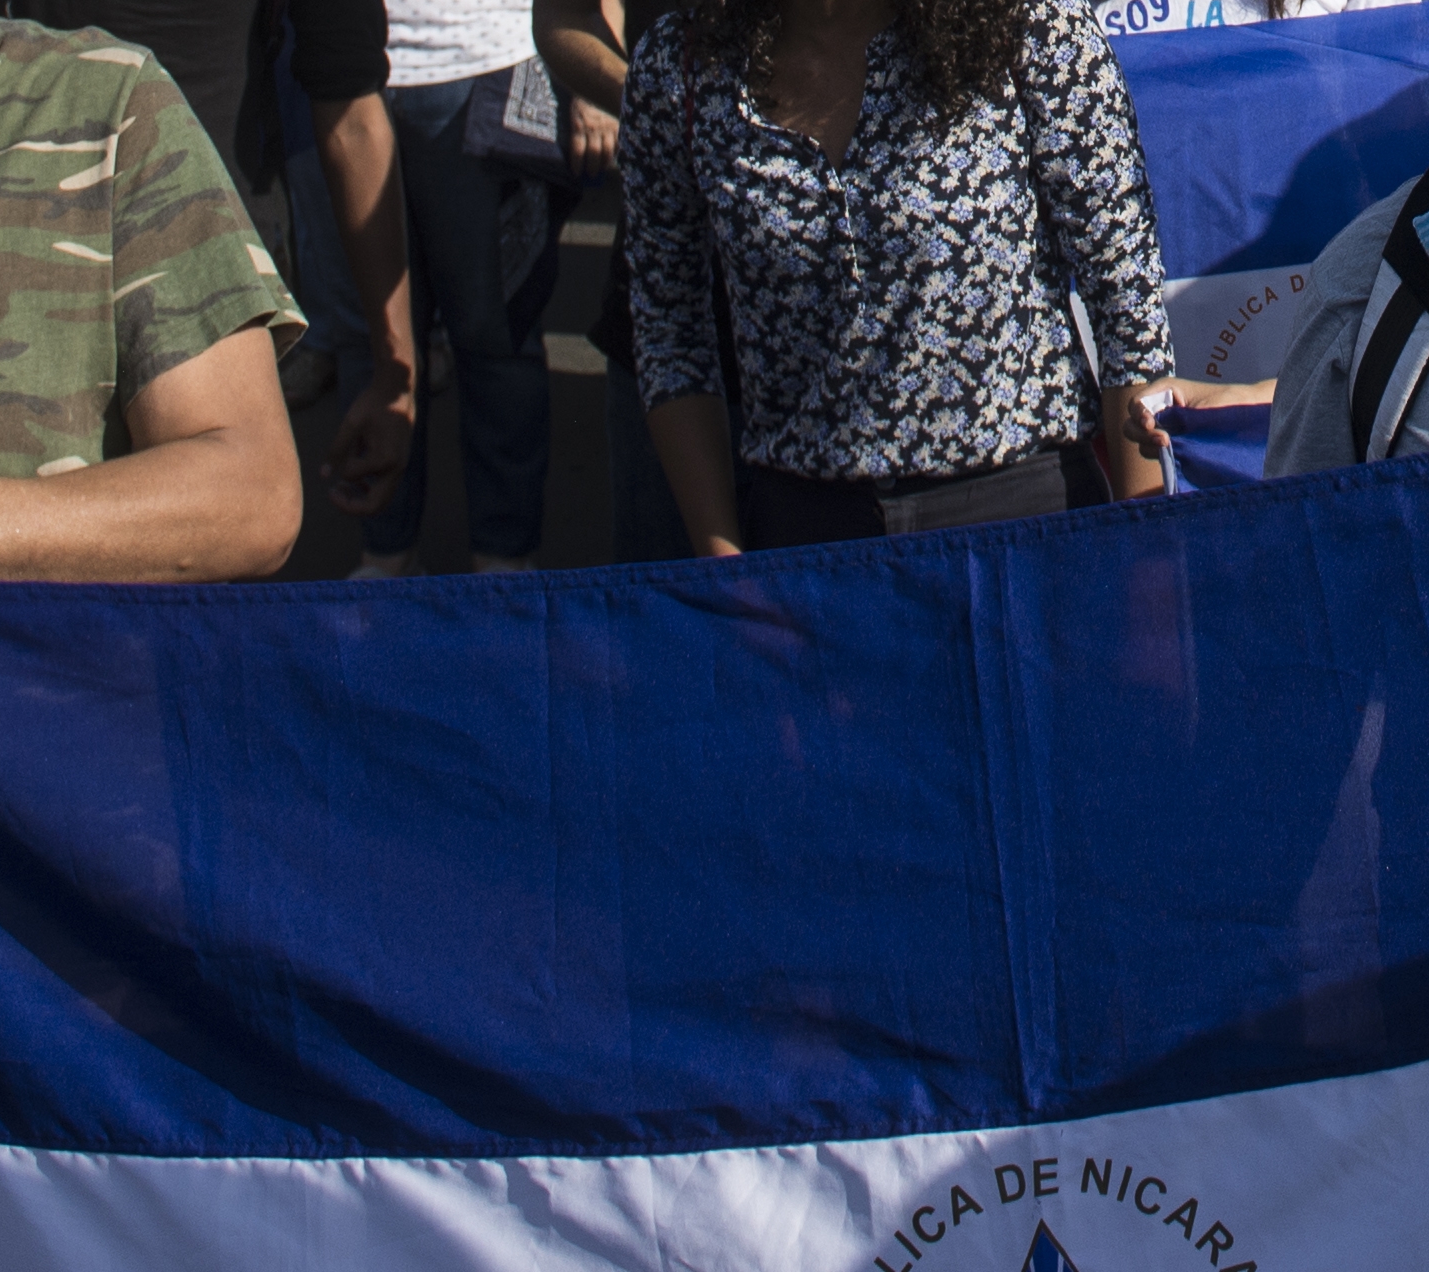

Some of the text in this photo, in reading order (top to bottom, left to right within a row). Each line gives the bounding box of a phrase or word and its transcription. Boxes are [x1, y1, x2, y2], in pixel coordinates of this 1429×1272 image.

[1186, 0, 1225, 29] LA
[1205, 285, 1279, 379] PUBLICA
[994, 1158, 1060, 1204] DE
